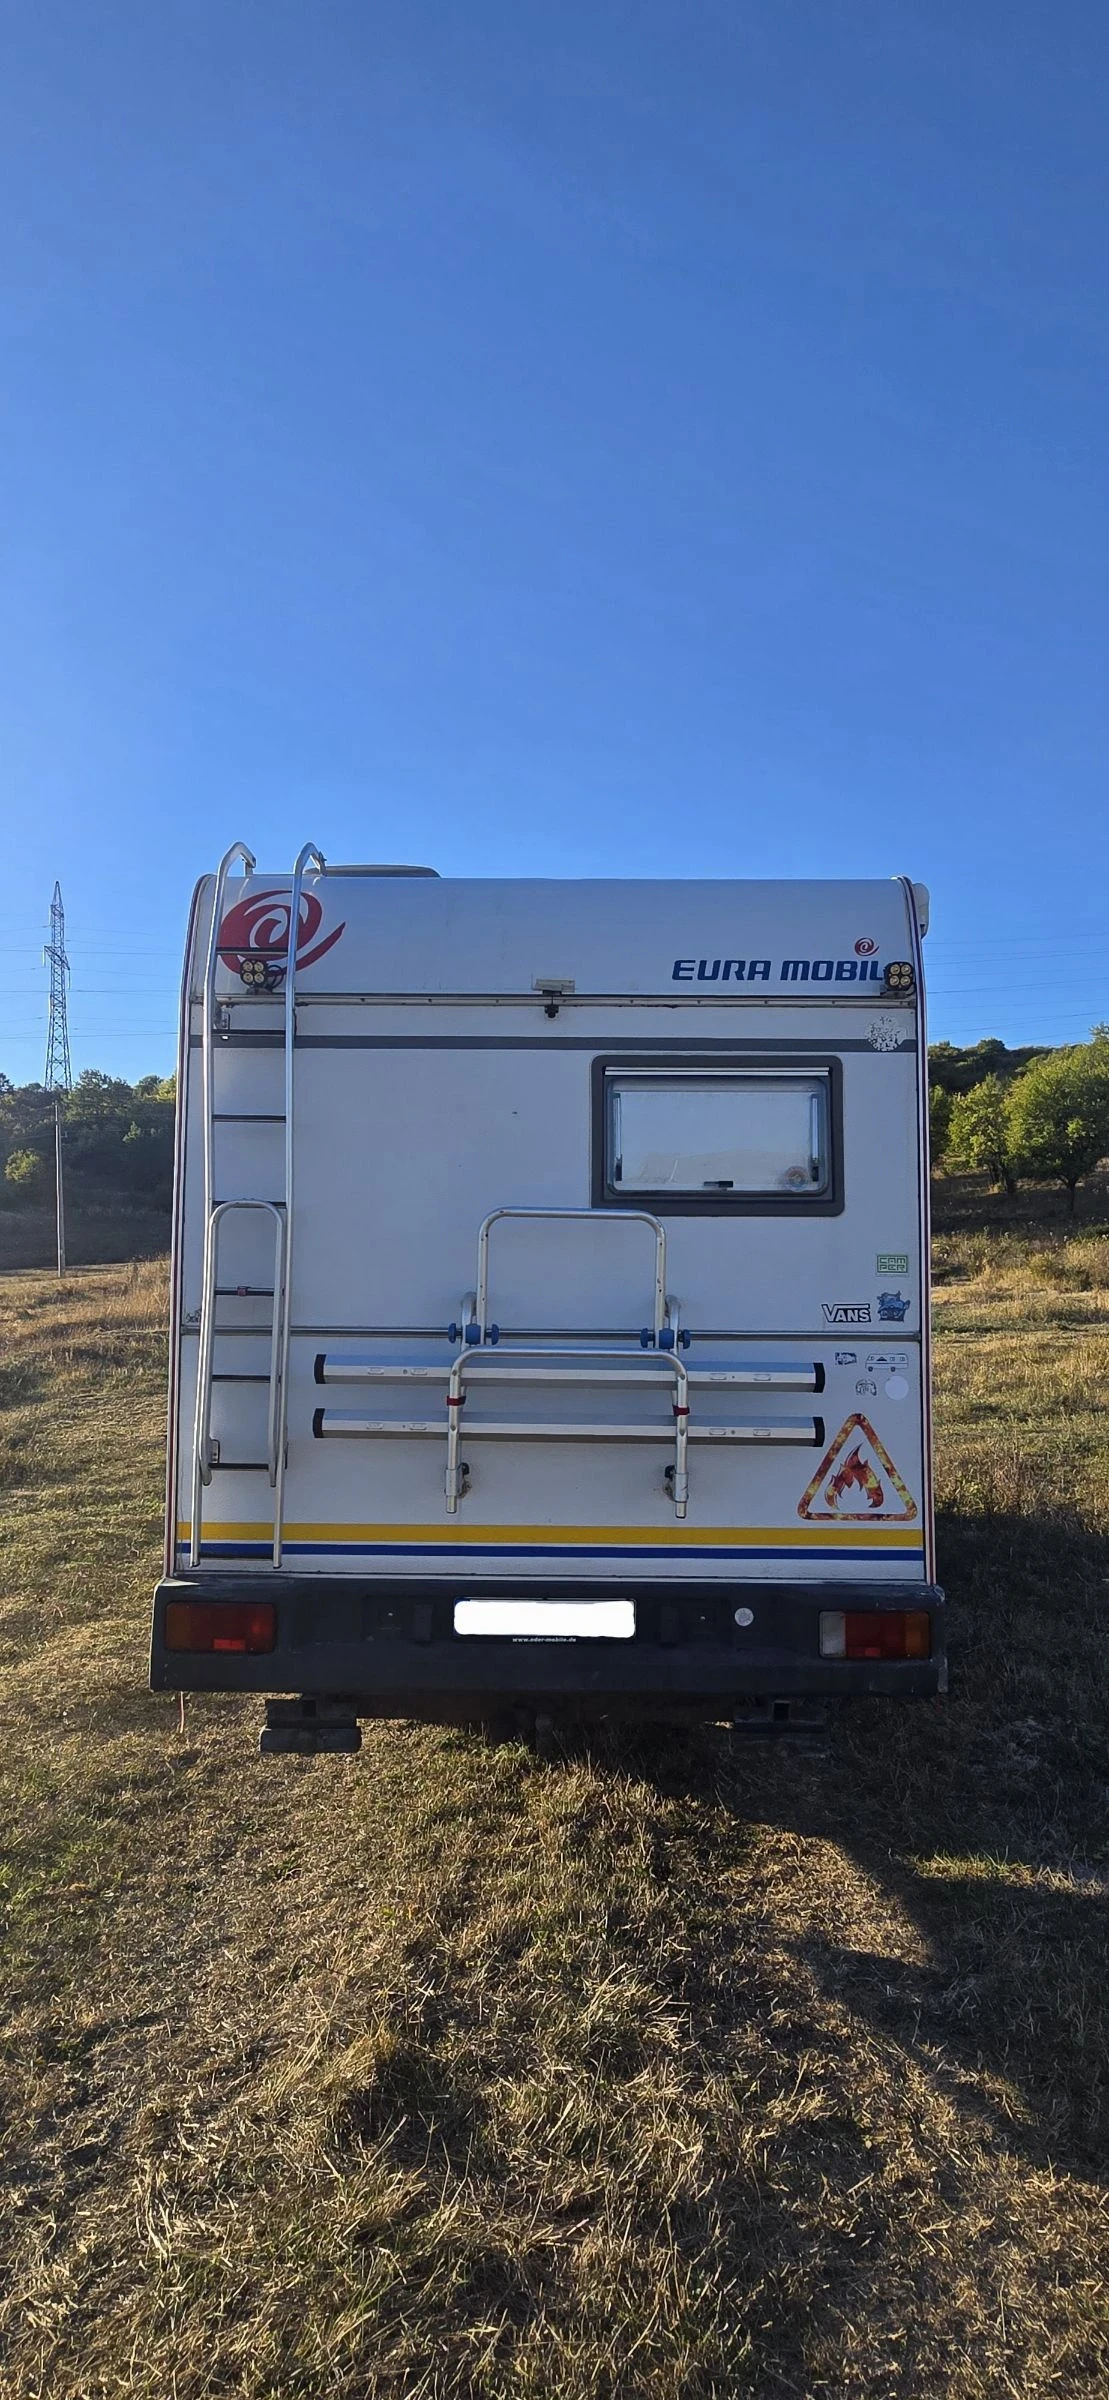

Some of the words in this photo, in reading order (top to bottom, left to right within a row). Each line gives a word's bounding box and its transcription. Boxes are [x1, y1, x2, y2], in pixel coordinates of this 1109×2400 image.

[671, 959, 772, 981] EURA
[780, 960, 884, 982] MOBIL
[821, 1303, 871, 1323] VANS
